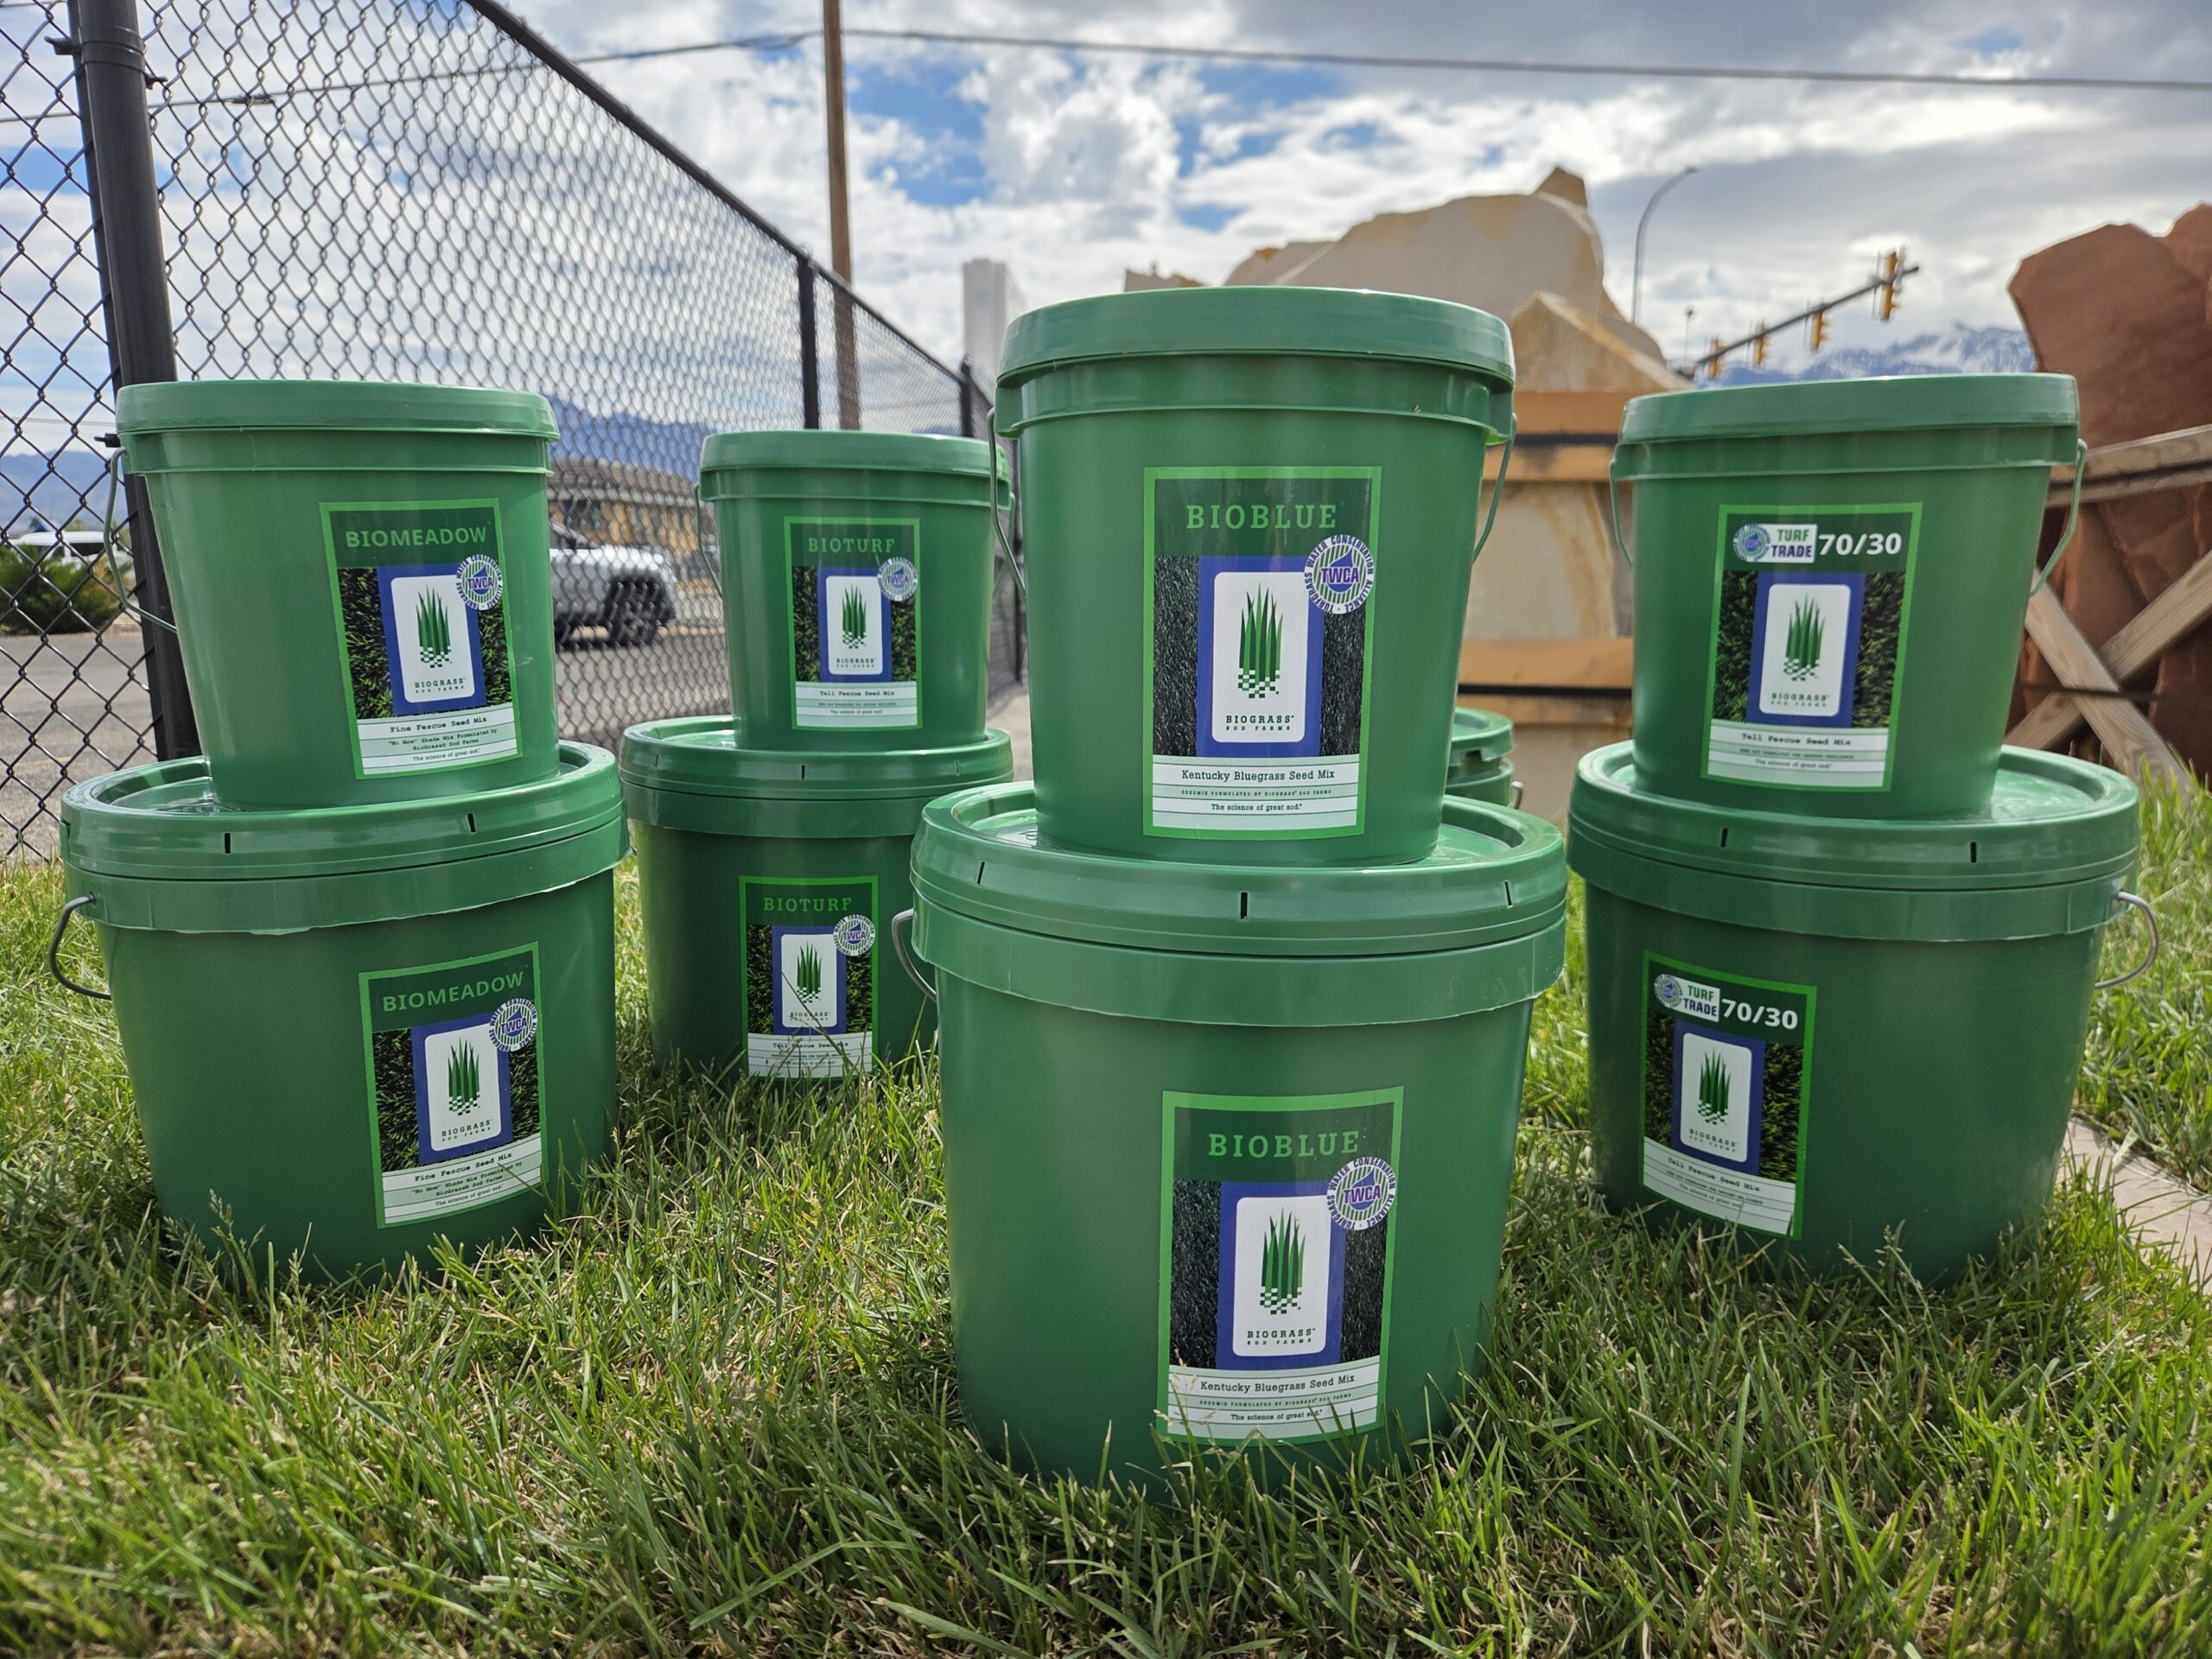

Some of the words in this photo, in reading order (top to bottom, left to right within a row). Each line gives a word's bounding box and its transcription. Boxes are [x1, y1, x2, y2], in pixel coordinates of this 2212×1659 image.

[1186, 505, 1337, 529] BIOBLUE
[346, 526, 487, 548] BIOMEADOW
[808, 537, 895, 553] BIOTURF
[1777, 529, 1809, 542] TURF
[1818, 532, 1902, 556] 70/30
[1306, 541, 1328, 568] WATER
[1331, 536, 1374, 575] CONSERVATION
[1771, 545, 1812, 558] TRADE
[467, 577, 493, 589] TWCA
[1321, 568, 1359, 583] TWCA
[1304, 572, 1333, 613] TURFGRASS
[1344, 580, 1373, 613] ALLIANCE
[1742, 733, 1763, 741] Tall
[1768, 735, 1801, 744] Fescue
[1182, 770, 1230, 782] Kentucky
[1234, 772, 1285, 782] Bluegrass
[1289, 771, 1313, 780] Seed
[1318, 770, 1335, 779] Mix
[763, 897, 852, 912] BIOTURF
[843, 931, 866, 940] TWCA
[383, 970, 524, 1013] BIOMEADOW
[1687, 985, 1714, 1002] TURF
[1683, 998, 1717, 1017] TRADE
[1721, 998, 1798, 1030] 70/30
[500, 1018, 527, 1034] TWCA
[1208, 1130, 1360, 1159] BIOBLUE
[414, 1173, 436, 1182] Fine
[441, 1166, 471, 1177] Fescue
[475, 1158, 494, 1167] Seed
[1329, 1165, 1351, 1191] WATER
[1353, 1157, 1396, 1189] CONSERVATION
[1344, 1185, 1381, 1204] TWCA
[1327, 1195, 1356, 1230] TURFGRASS
[1367, 1193, 1395, 1227] ALLIANCE
[1247, 1329, 1312, 1338] BIOGRASS
[1201, 1382, 1251, 1393] Kentucky
[1255, 1382, 1306, 1393] Bluegrass
[1310, 1378, 1334, 1389] Seed
[1338, 1375, 1355, 1384] Mix
[1286, 1412, 1305, 1421] great
